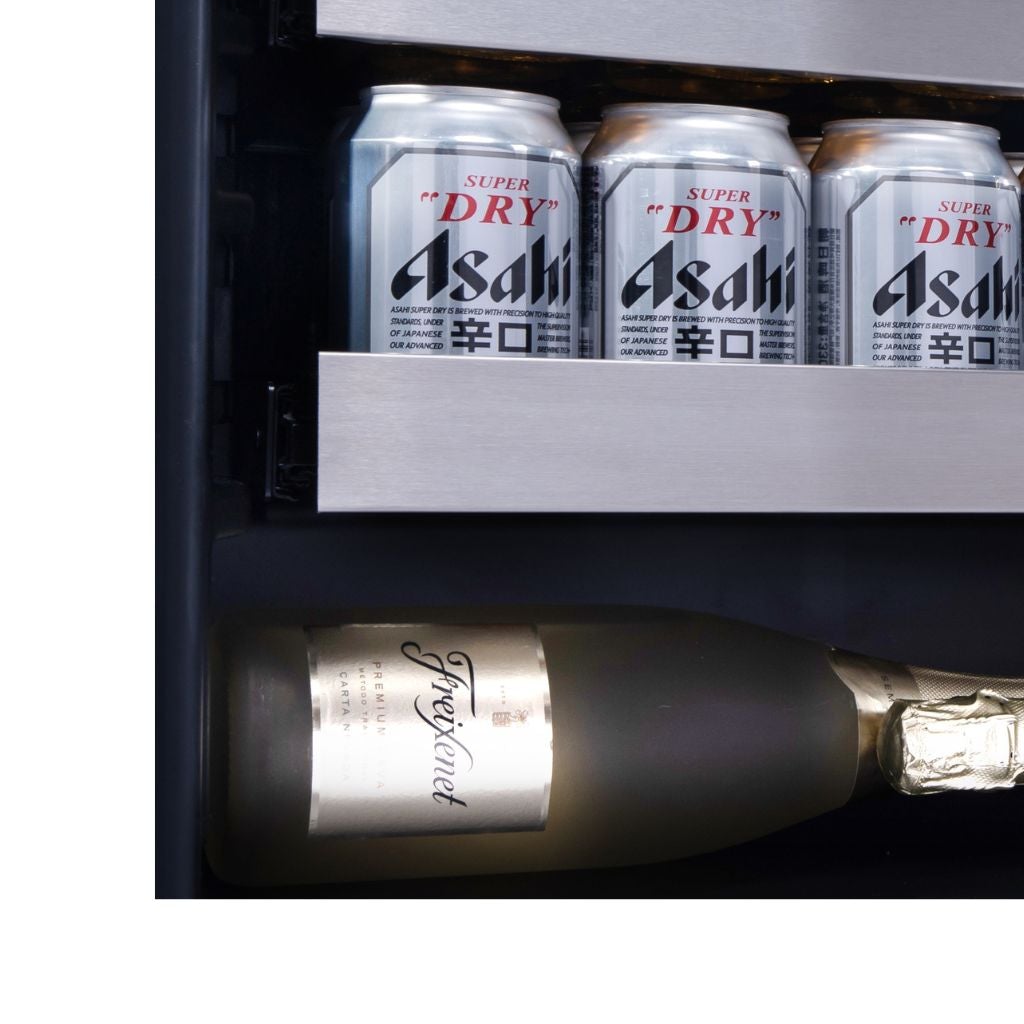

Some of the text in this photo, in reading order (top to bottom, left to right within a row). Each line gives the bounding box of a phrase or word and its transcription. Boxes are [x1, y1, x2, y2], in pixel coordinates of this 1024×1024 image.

[464, 175, 530, 192] SUPER
[687, 187, 750, 203] SUPER
[938, 201, 992, 215] SUPER
[391, 229, 571, 306] Asahi
[621, 240, 795, 314] Asahi
[872, 250, 1020, 322] Asahi
[391, 306, 410, 314] ASAHI
[433, 307, 447, 315] DRY
[455, 308, 483, 316] BREWED
[484, 309, 502, 317] WITH
[503, 310, 534, 318] PRECISION
[659, 315, 672, 323] DRY
[724, 317, 755, 325] PRECISION
[424, 319, 444, 327] UNDER
[650, 326, 669, 334] UNDER
[390, 330, 443, 338] OF JAPANESE
[451, 318, 532, 353] 辛口
[631, 337, 668, 345] JAPANESE
[675, 325, 754, 359] 辛口
[390, 342, 444, 350] OUR ADVANCED
[928, 332, 995, 365] 辛口
[887, 354, 923, 362] ADVANCED
[339, 671, 351, 716] CARTA
[881, 672, 895, 703] SEM
[401, 641, 476, 808] Freixenet
